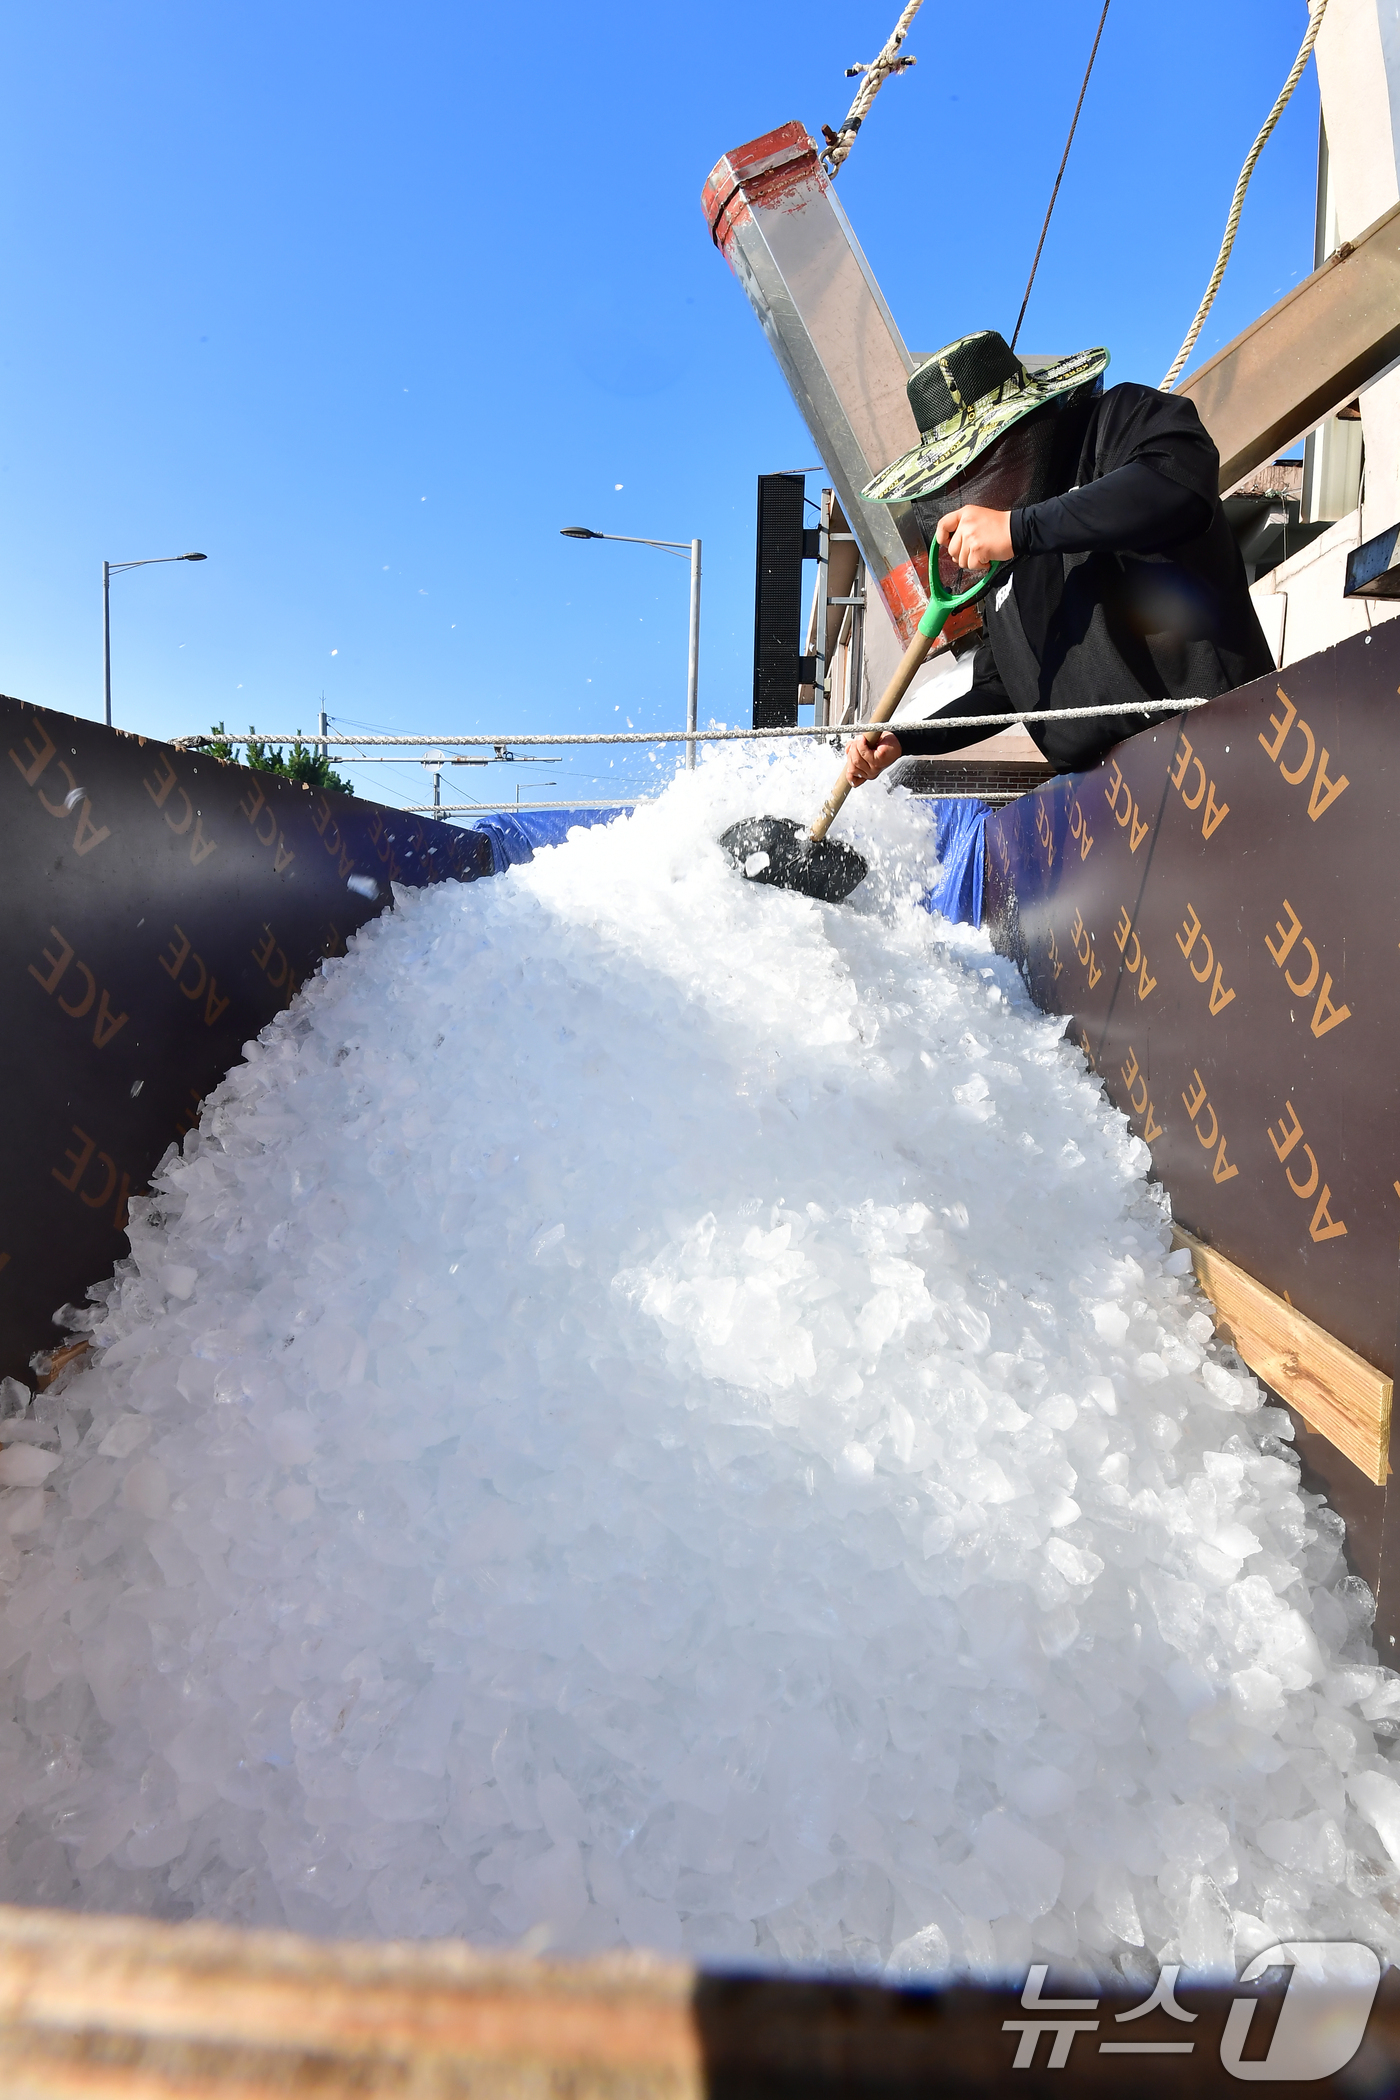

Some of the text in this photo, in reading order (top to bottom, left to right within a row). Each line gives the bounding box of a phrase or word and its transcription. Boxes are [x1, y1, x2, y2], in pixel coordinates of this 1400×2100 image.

[9, 717, 111, 857] ACE
[1104, 759, 1149, 854] ACE
[1166, 732, 1229, 840] ACE
[1259, 687, 1350, 822] ACE
[142, 752, 217, 865] ACE
[240, 778, 294, 874] ACE
[311, 796, 354, 879] ACE
[368, 811, 401, 882] ACE
[1035, 795, 1055, 867] ACE
[28, 927, 129, 1049] ACE
[158, 924, 230, 1027] ACE
[1070, 907, 1102, 990] ACE
[1113, 905, 1158, 1001] ACE
[1175, 903, 1236, 1016] ACE
[1264, 898, 1353, 1038] ACE
[1120, 1046, 1163, 1144] ACE
[1181, 1068, 1239, 1184] ACE
[1267, 1100, 1348, 1243] ACE
